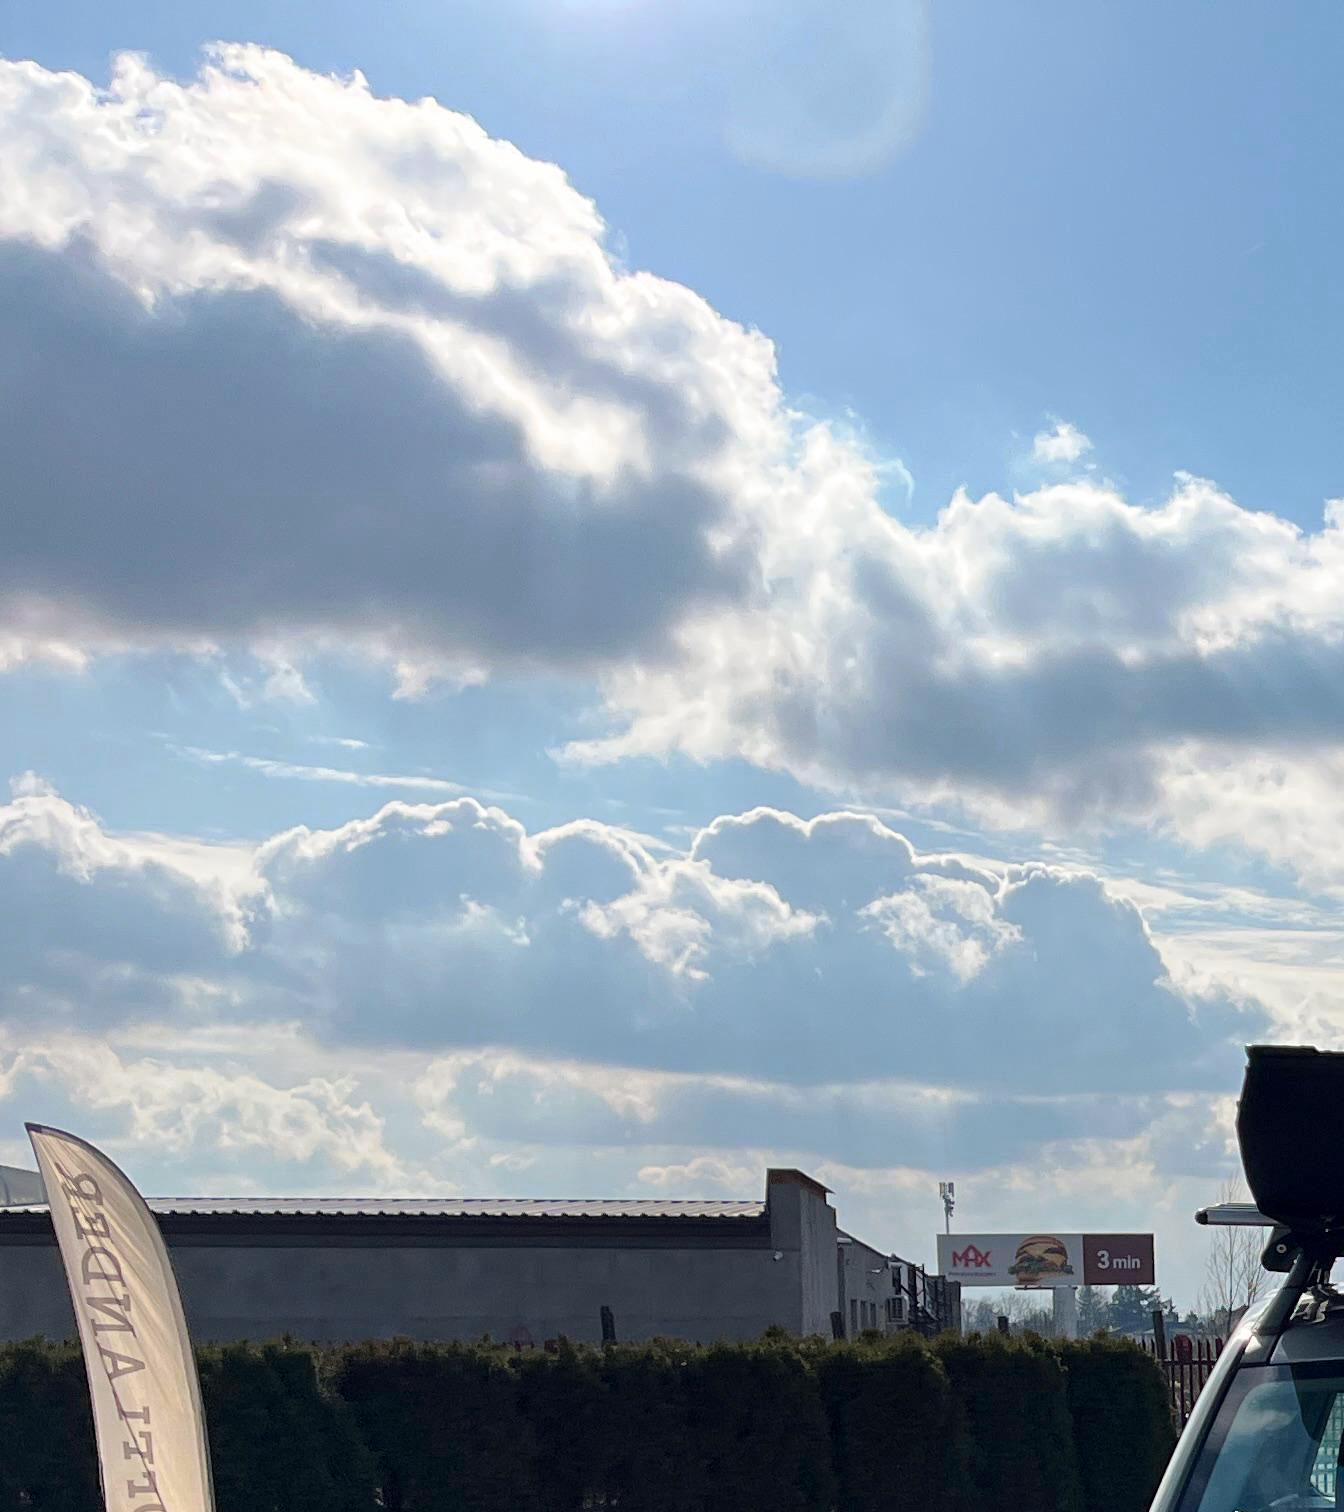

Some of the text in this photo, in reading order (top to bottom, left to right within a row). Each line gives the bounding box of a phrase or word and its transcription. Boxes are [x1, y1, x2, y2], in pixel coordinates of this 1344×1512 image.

[952, 1244, 992, 1268] MAX
[1097, 1249, 1141, 1269] 3 min
